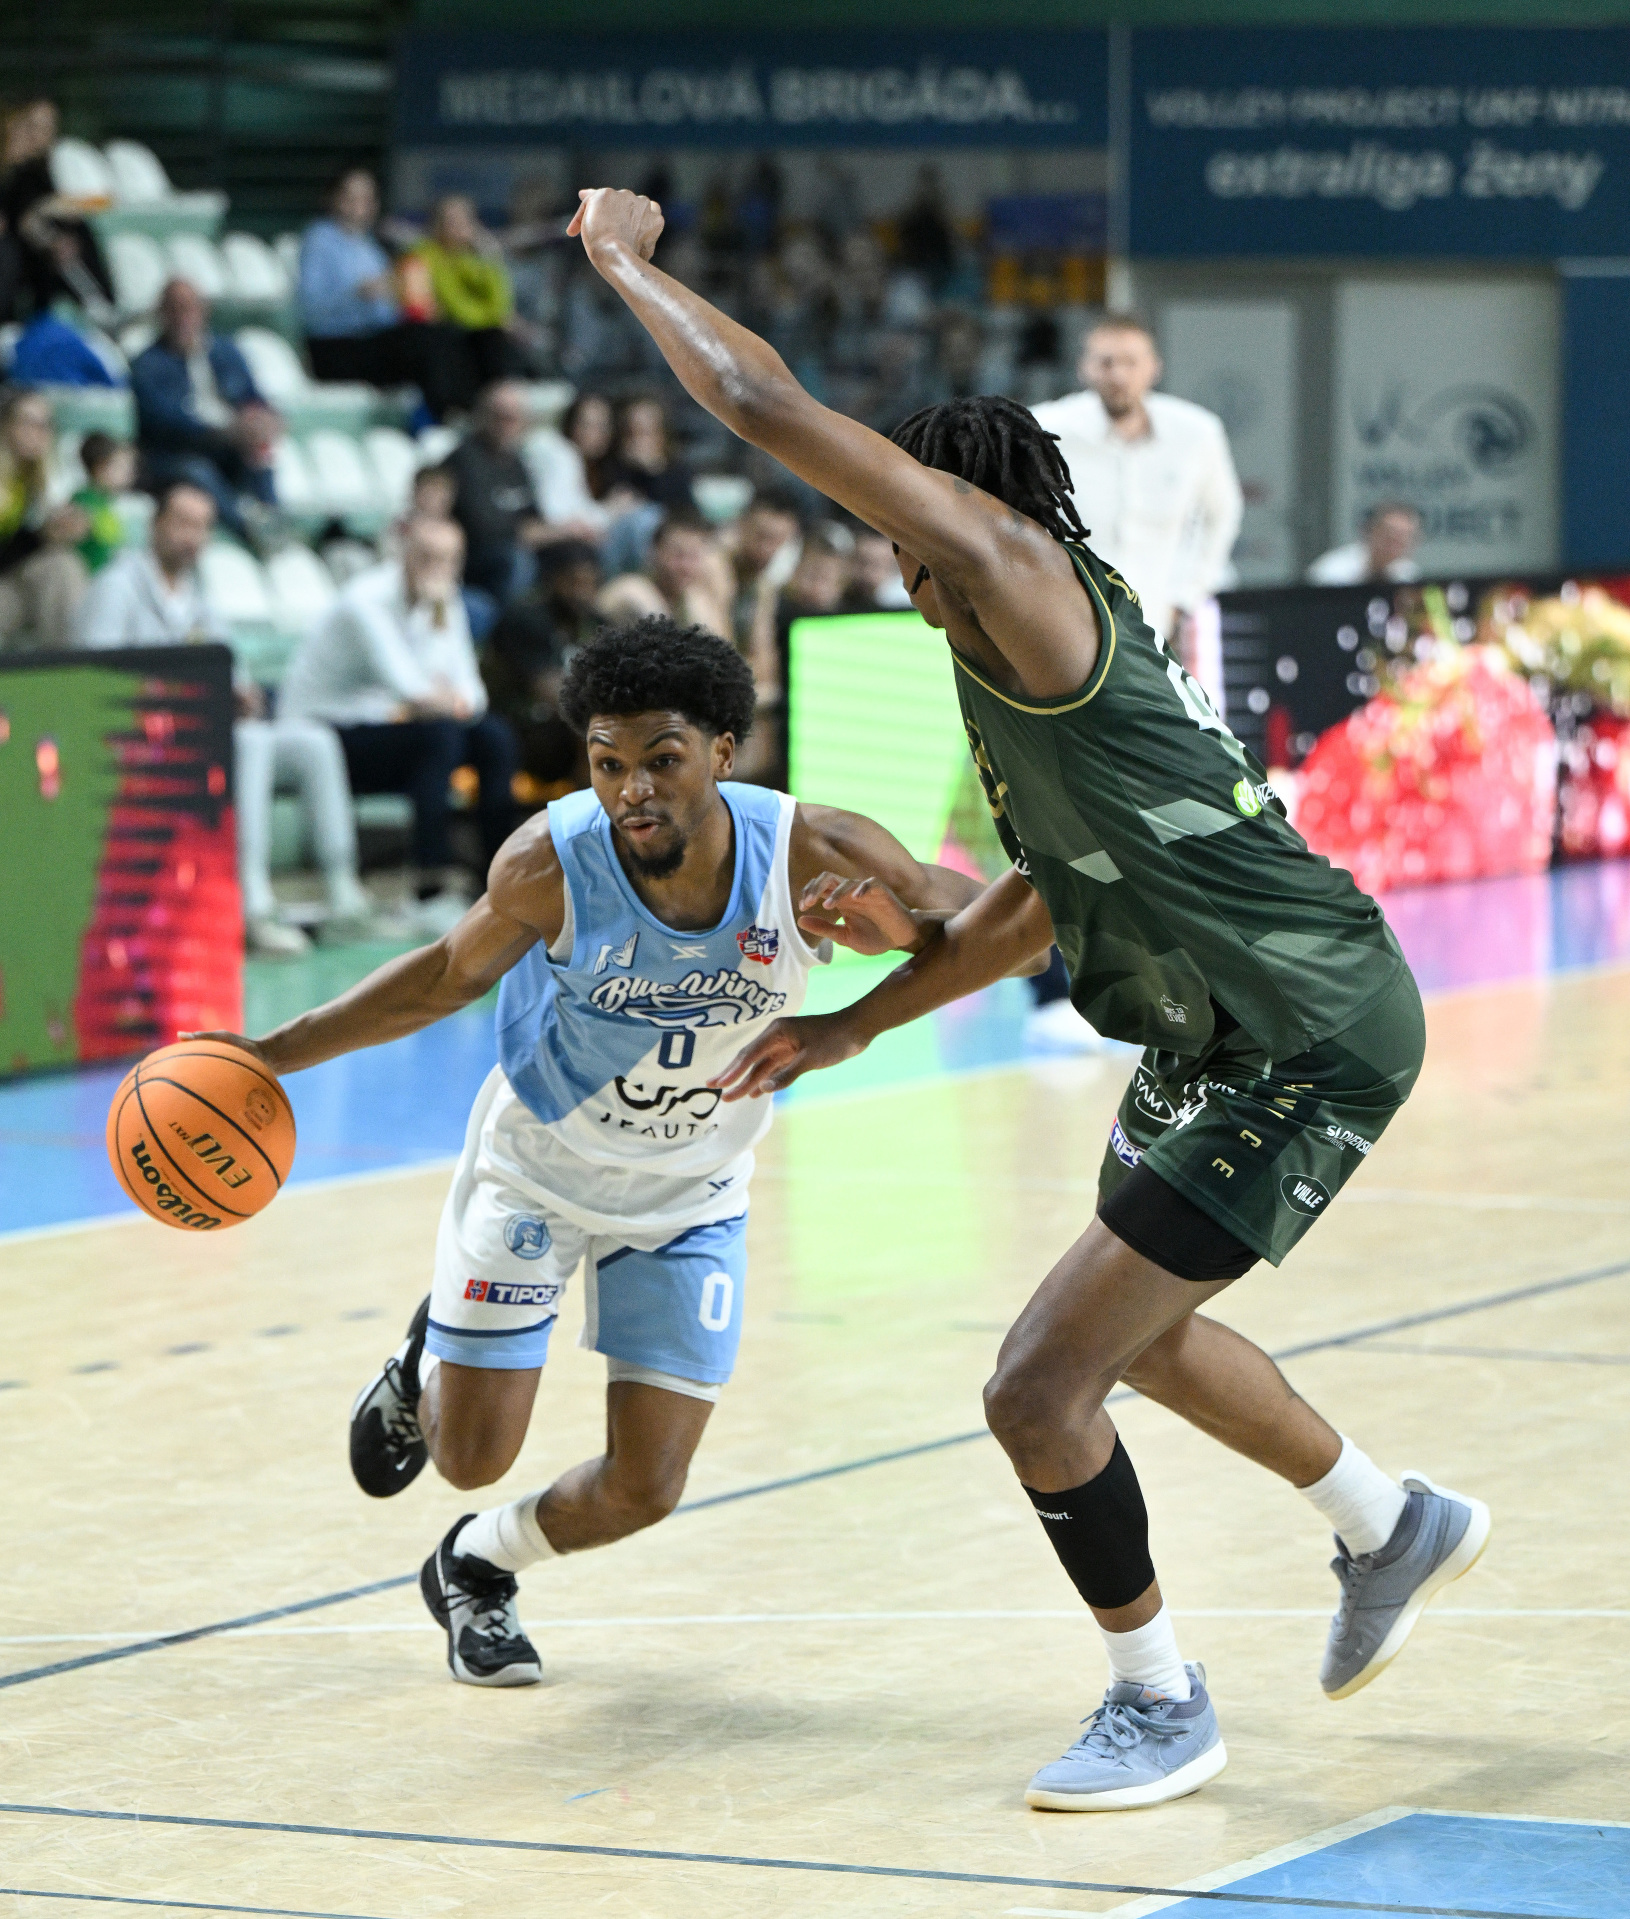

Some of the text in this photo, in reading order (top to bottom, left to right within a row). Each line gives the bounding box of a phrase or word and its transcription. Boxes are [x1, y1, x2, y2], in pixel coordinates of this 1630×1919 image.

[1206, 140, 1606, 211] extraliga ženy
[743, 941, 777, 956] SIL
[658, 1029, 696, 1070] 0
[168, 1121, 191, 1141] NXT
[131, 1140, 222, 1231] Wilson
[186, 1132, 253, 1190] EVO
[494, 1285, 557, 1304] TIPOS
[698, 1271, 734, 1332] 0
